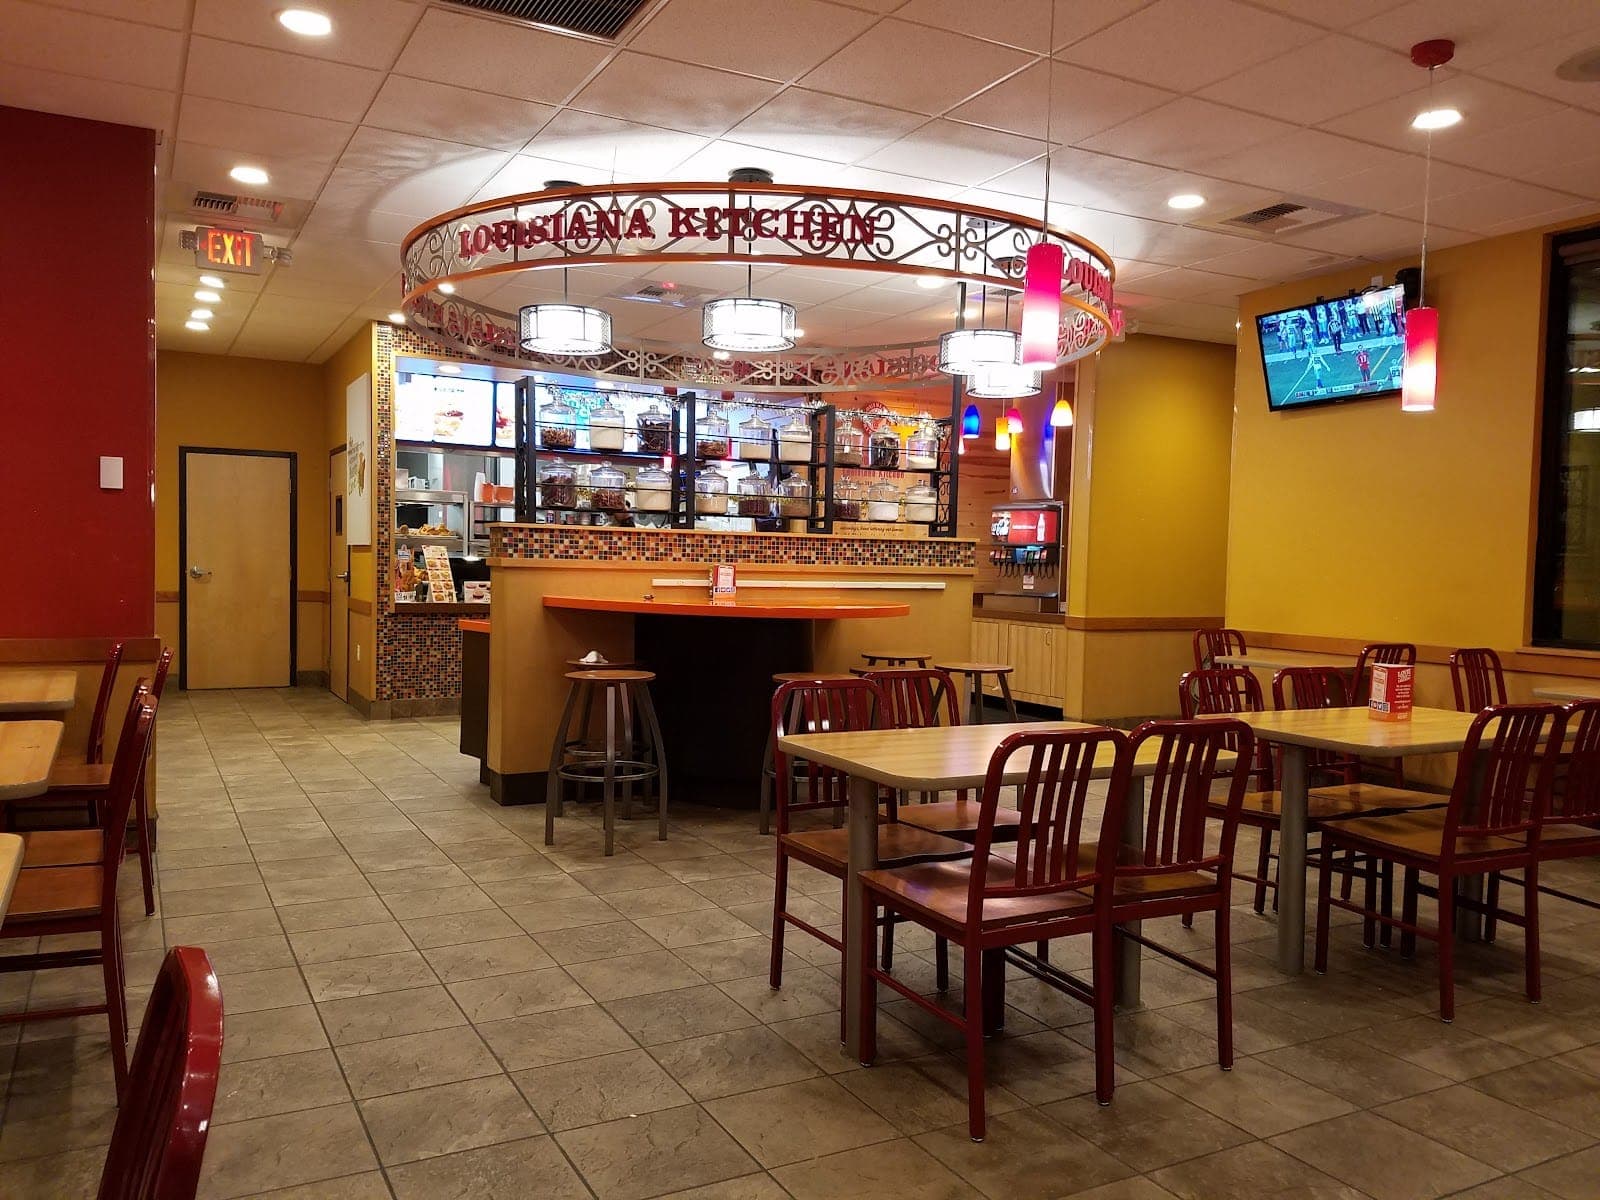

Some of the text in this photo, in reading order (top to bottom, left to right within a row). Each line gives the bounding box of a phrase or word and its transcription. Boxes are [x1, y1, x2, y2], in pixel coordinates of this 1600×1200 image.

[207, 230, 254, 266] EXIT
[458, 207, 881, 260] LOUISIANA KITCHEN
